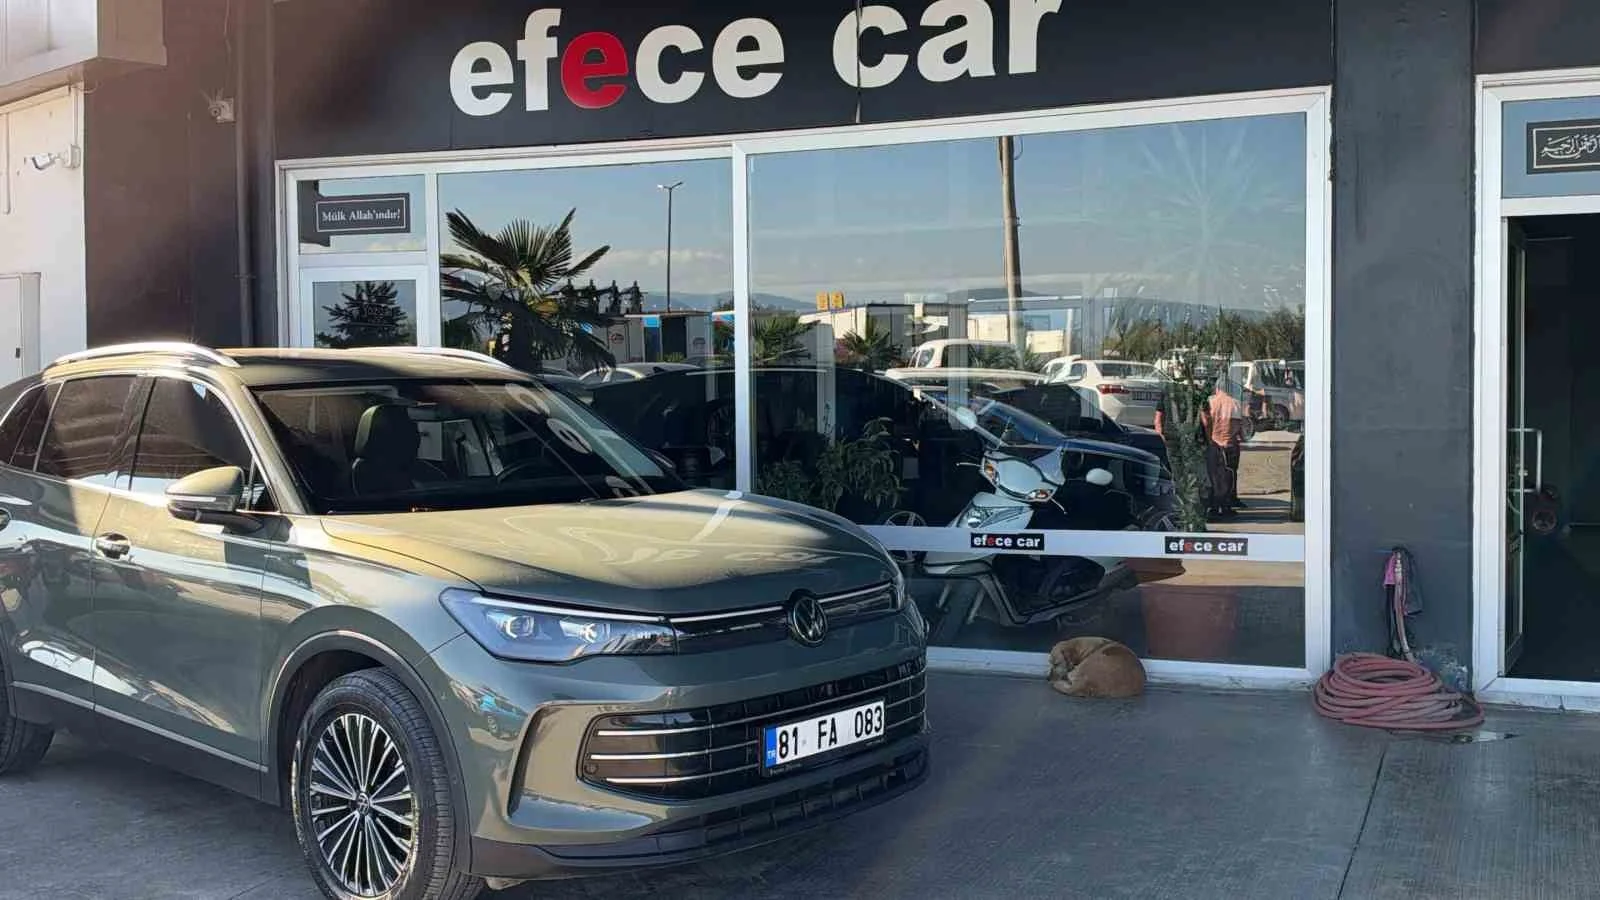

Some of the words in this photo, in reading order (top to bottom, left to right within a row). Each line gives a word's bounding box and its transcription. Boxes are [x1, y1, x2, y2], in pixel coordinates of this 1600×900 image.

[449, 8, 785, 116] efece
[832, 0, 1063, 88] car
[322, 210, 346, 221] Mülk
[973, 534, 1013, 547] efece
[1016, 537, 1041, 547] car
[1169, 539, 1213, 552] efece
[1218, 542, 1245, 552] car
[779, 727, 799, 759] 81
[818, 717, 838, 749] FA
[854, 705, 883, 738] 083
